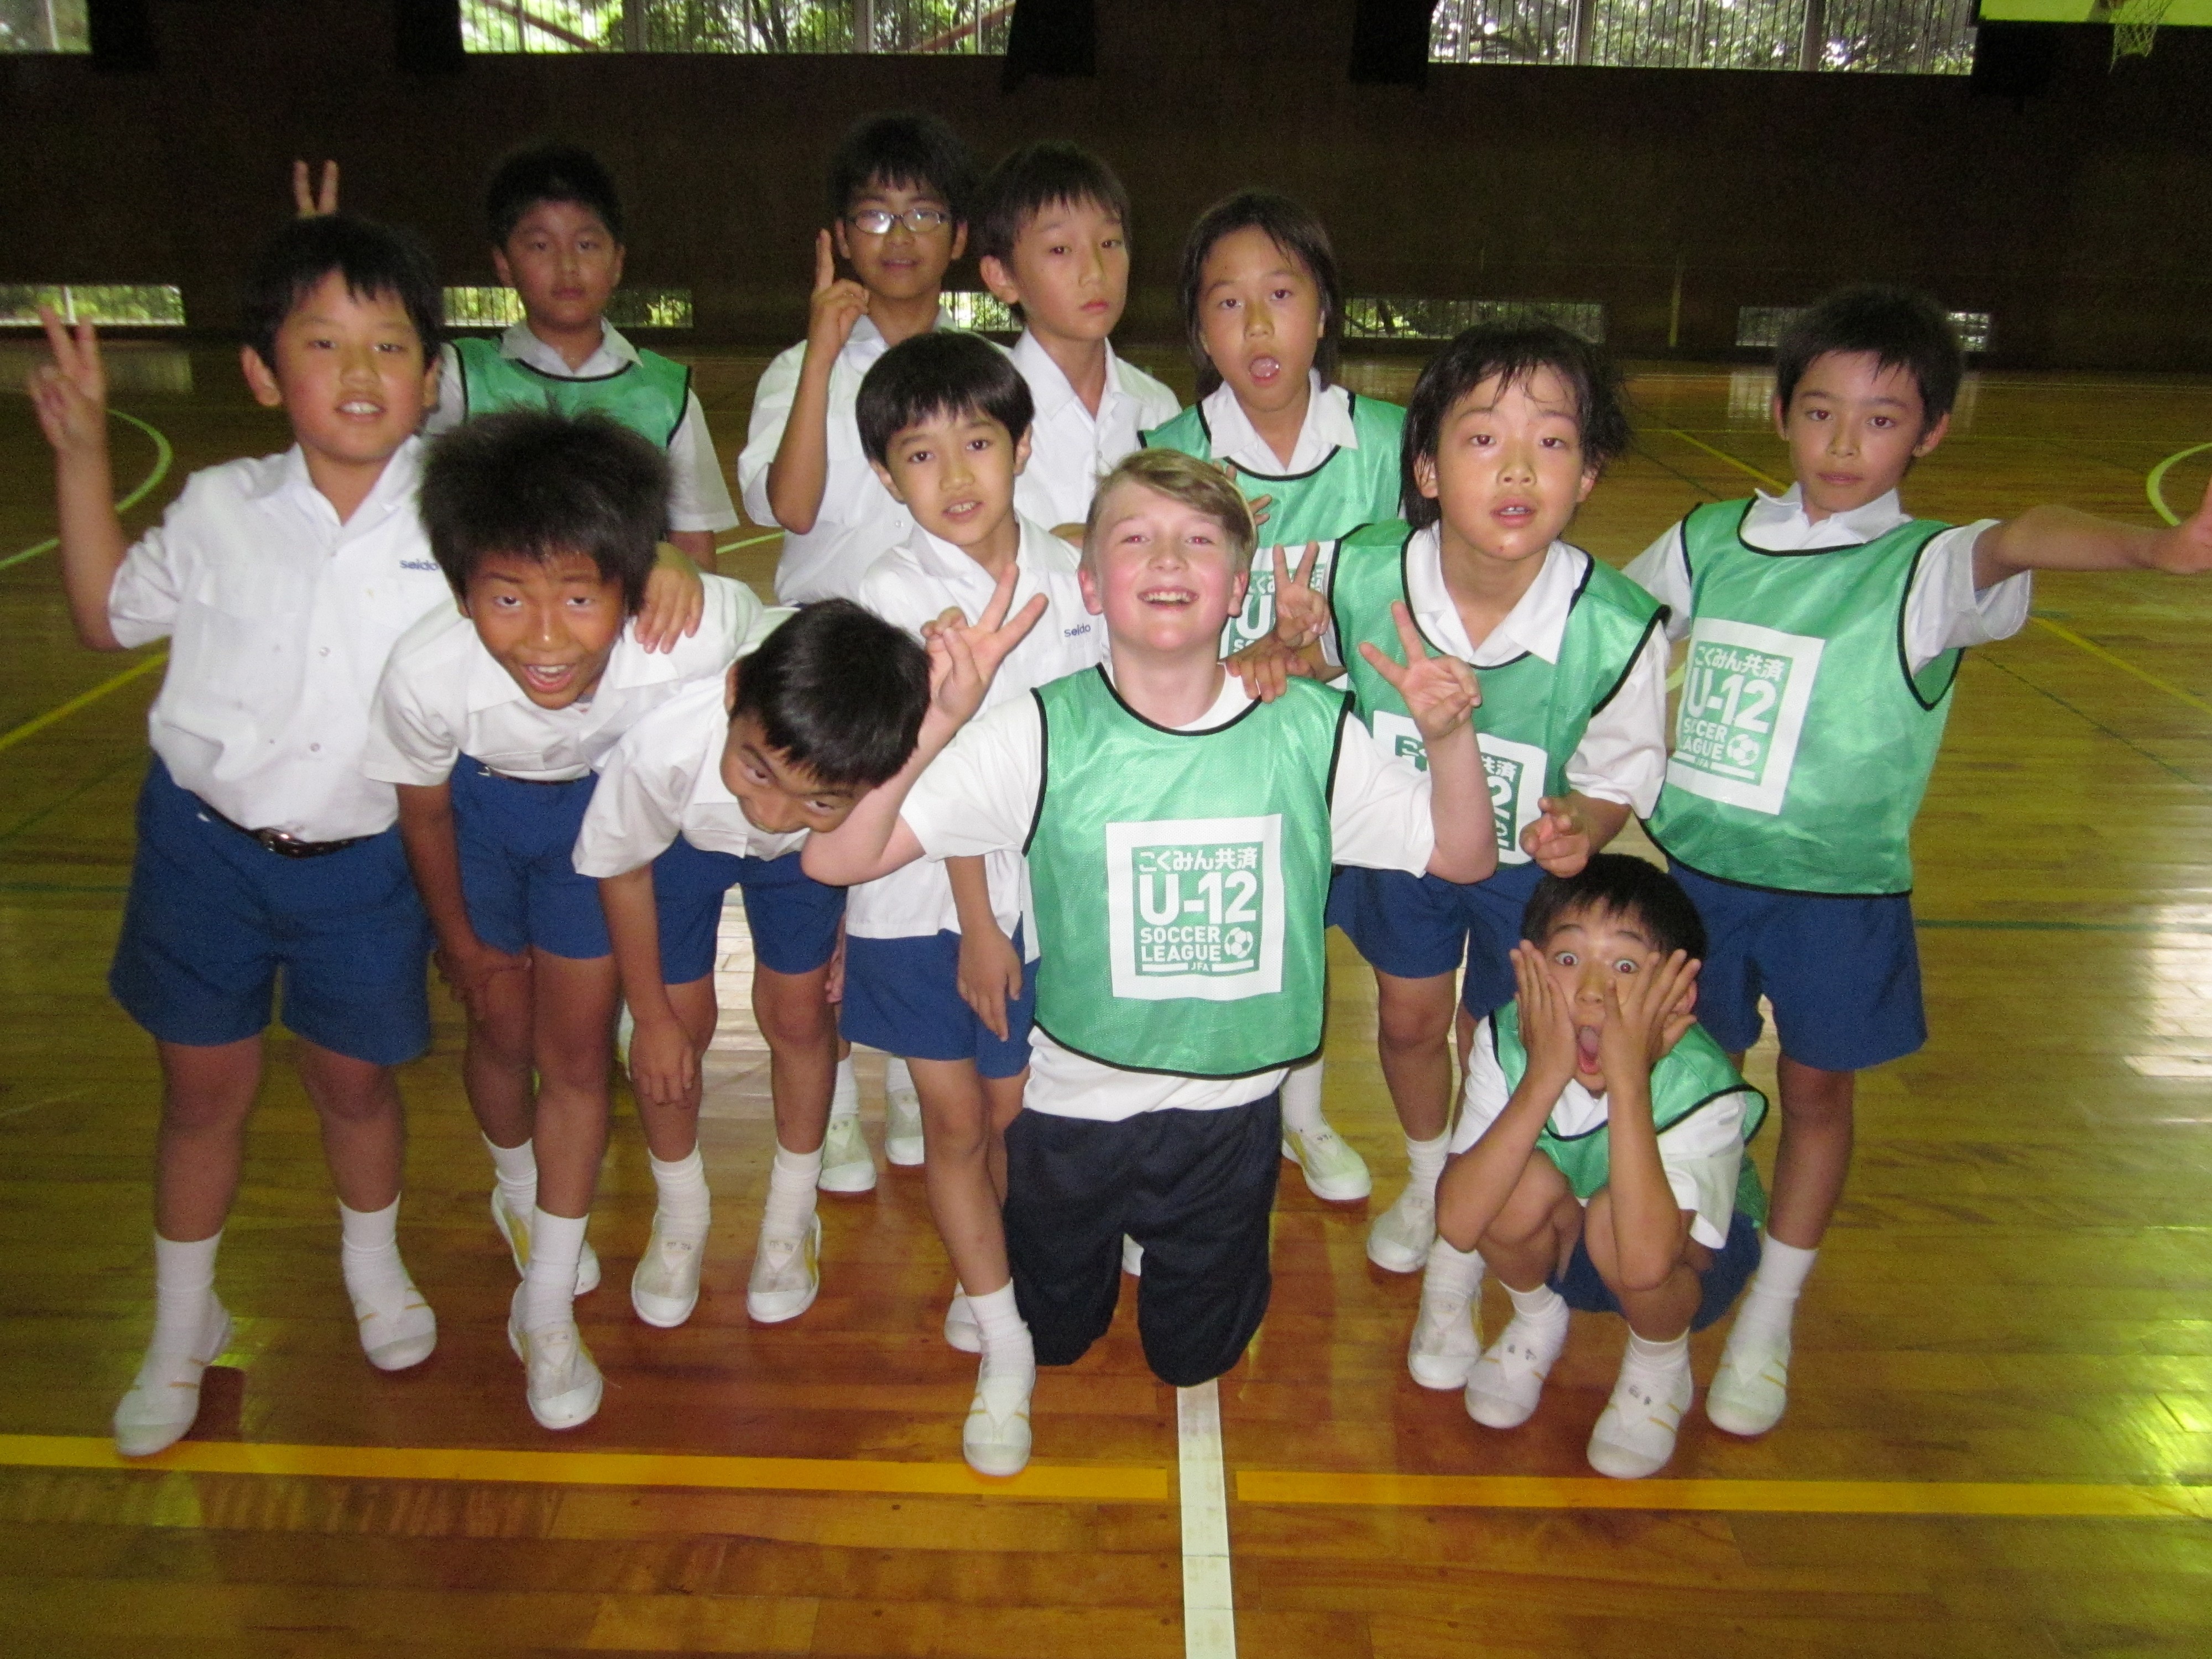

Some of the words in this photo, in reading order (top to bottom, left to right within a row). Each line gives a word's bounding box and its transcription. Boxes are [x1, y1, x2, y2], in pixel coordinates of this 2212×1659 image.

[1694, 646, 1786, 682] こくみん共済
[1687, 667, 1777, 734] U-12
[1139, 847, 1258, 872] こくみん共済
[1139, 870, 1257, 926] U-12
[1140, 926, 1221, 944] SOCCER
[1141, 944, 1222, 962] LEAGUE
[1191, 961, 1209, 972] JFA
